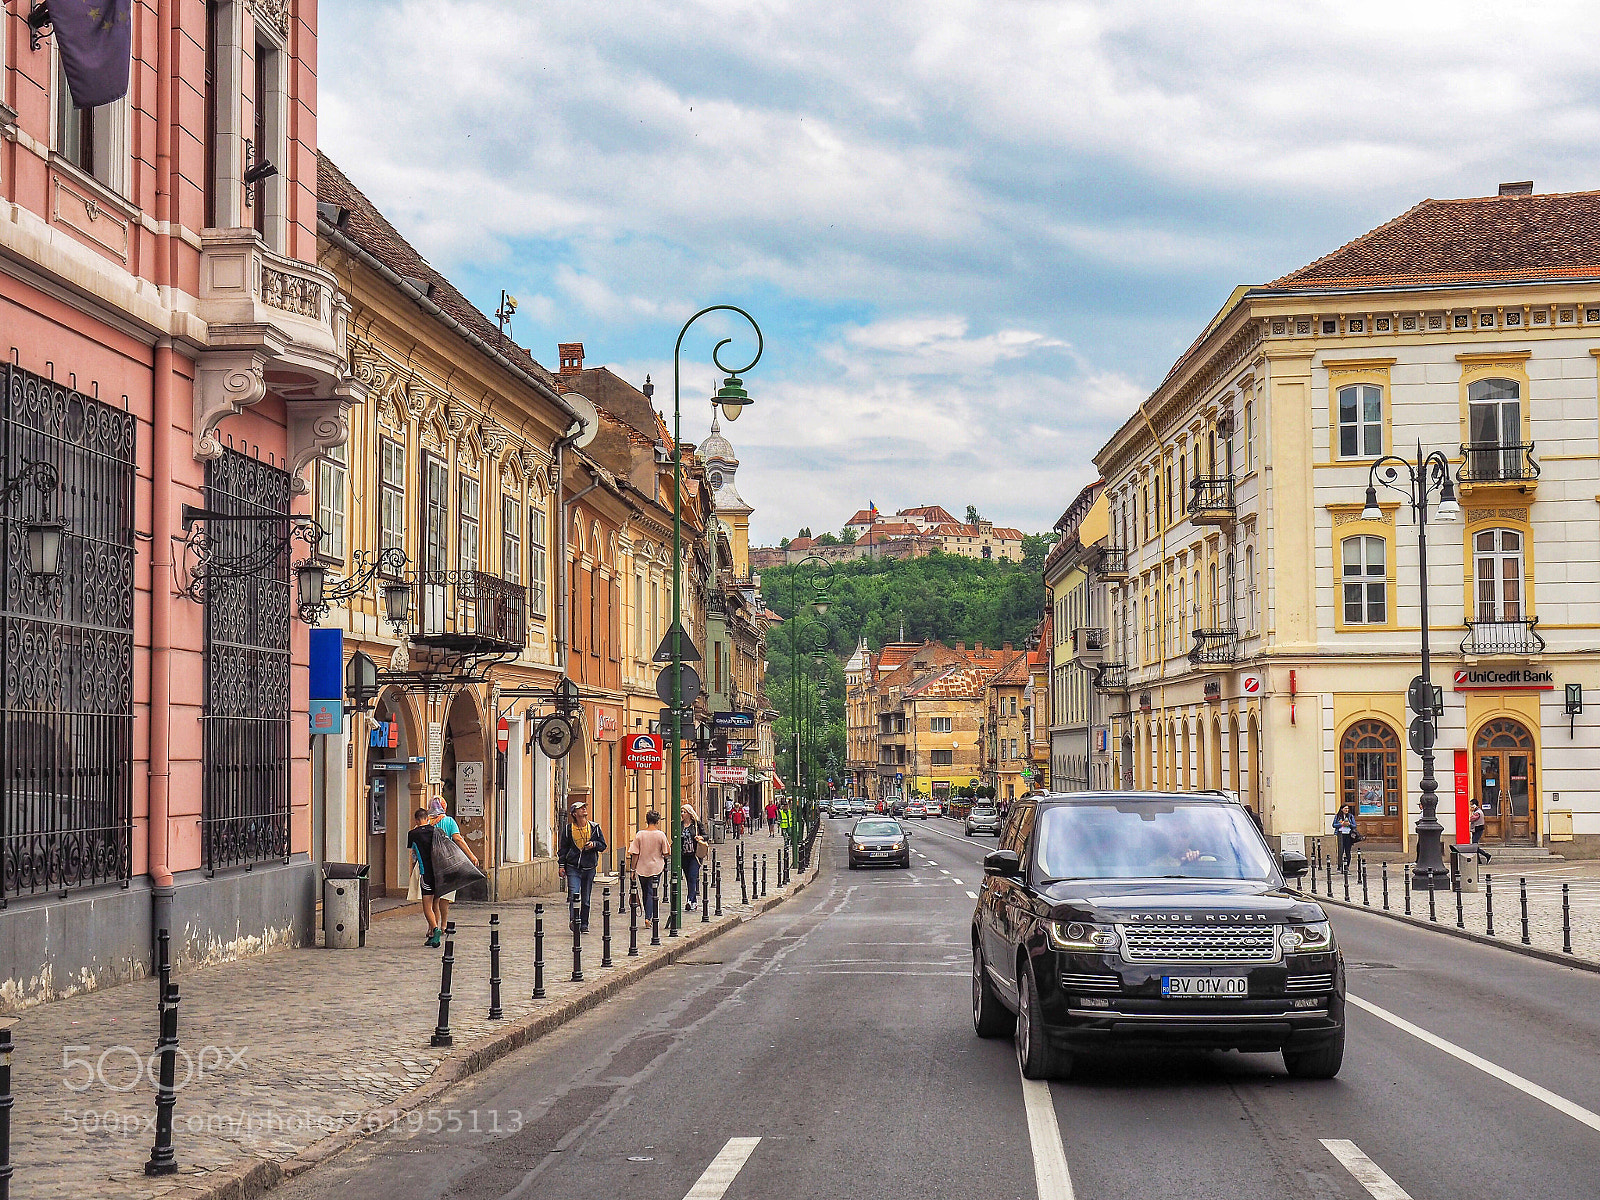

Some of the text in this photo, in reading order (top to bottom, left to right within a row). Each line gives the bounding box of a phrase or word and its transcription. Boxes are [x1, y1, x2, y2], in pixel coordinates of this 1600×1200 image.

[1468, 669, 1554, 683] UniCredit Bank
[627, 754, 661, 762] Christian
[635, 761, 652, 769] Tour
[1170, 979, 1190, 992] BV
